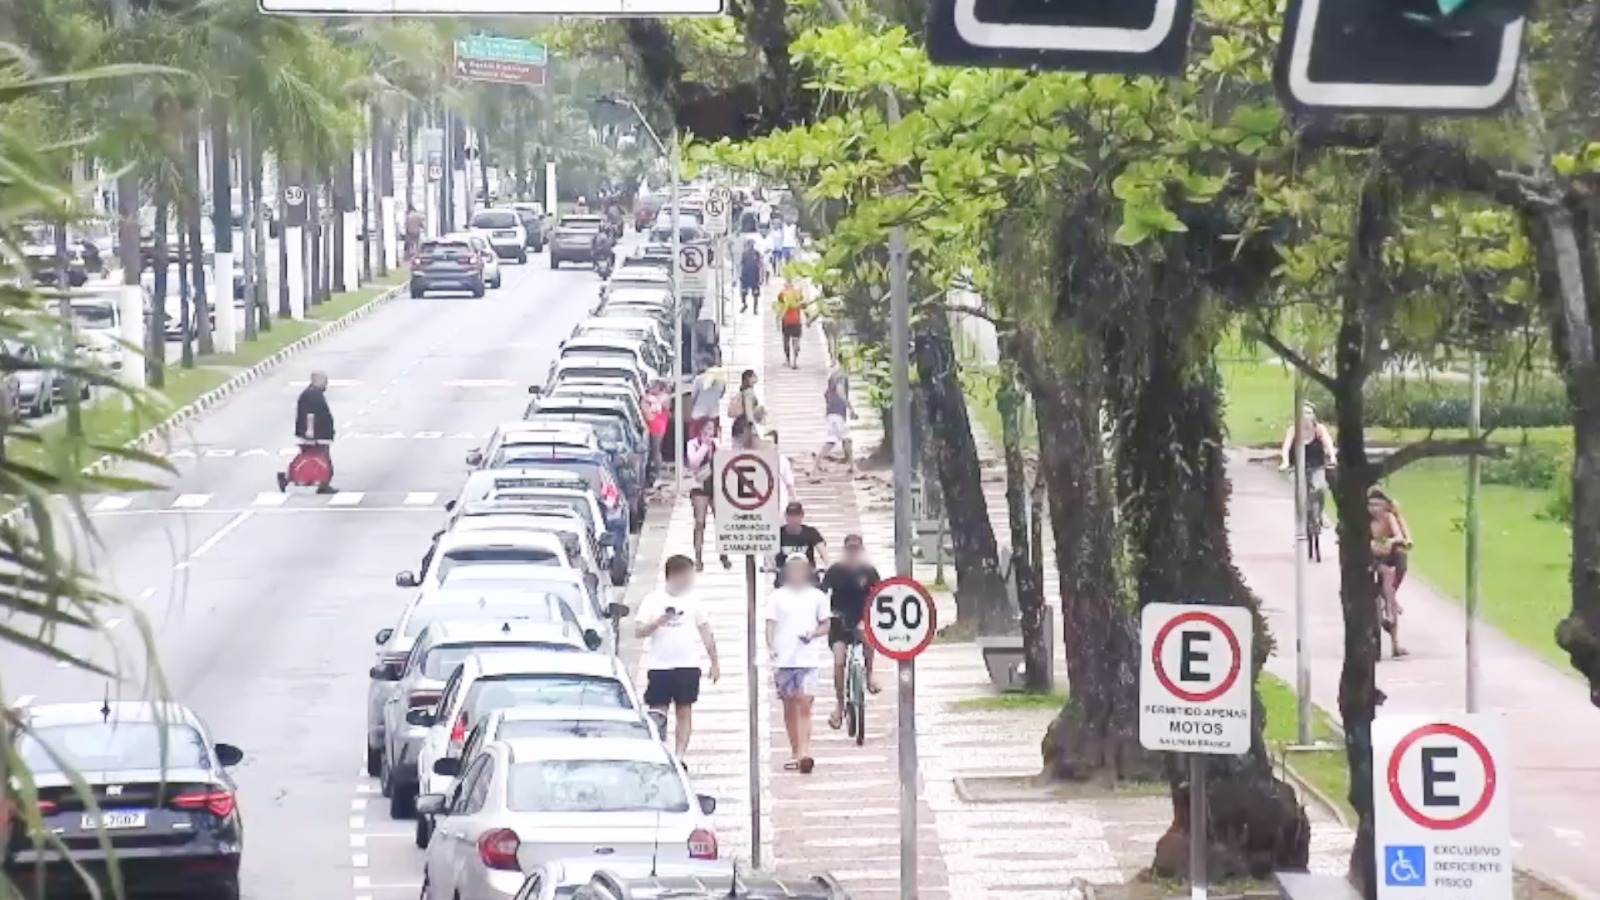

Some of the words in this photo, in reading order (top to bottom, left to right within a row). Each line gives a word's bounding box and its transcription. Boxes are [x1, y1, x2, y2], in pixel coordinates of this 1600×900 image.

[287, 190, 302, 199] 50
[738, 466, 756, 498] E
[876, 595, 922, 629] 50
[1180, 631, 1211, 682] E
[1144, 705, 1201, 716] PERMITIDO
[1204, 708, 1247, 719] APENAS
[1170, 721, 1223, 736] MOTOS
[1421, 747, 1460, 806] E
[1433, 845, 1500, 857] EXCLUSIVO
[1434, 861, 1502, 873] DEFICIENTE
